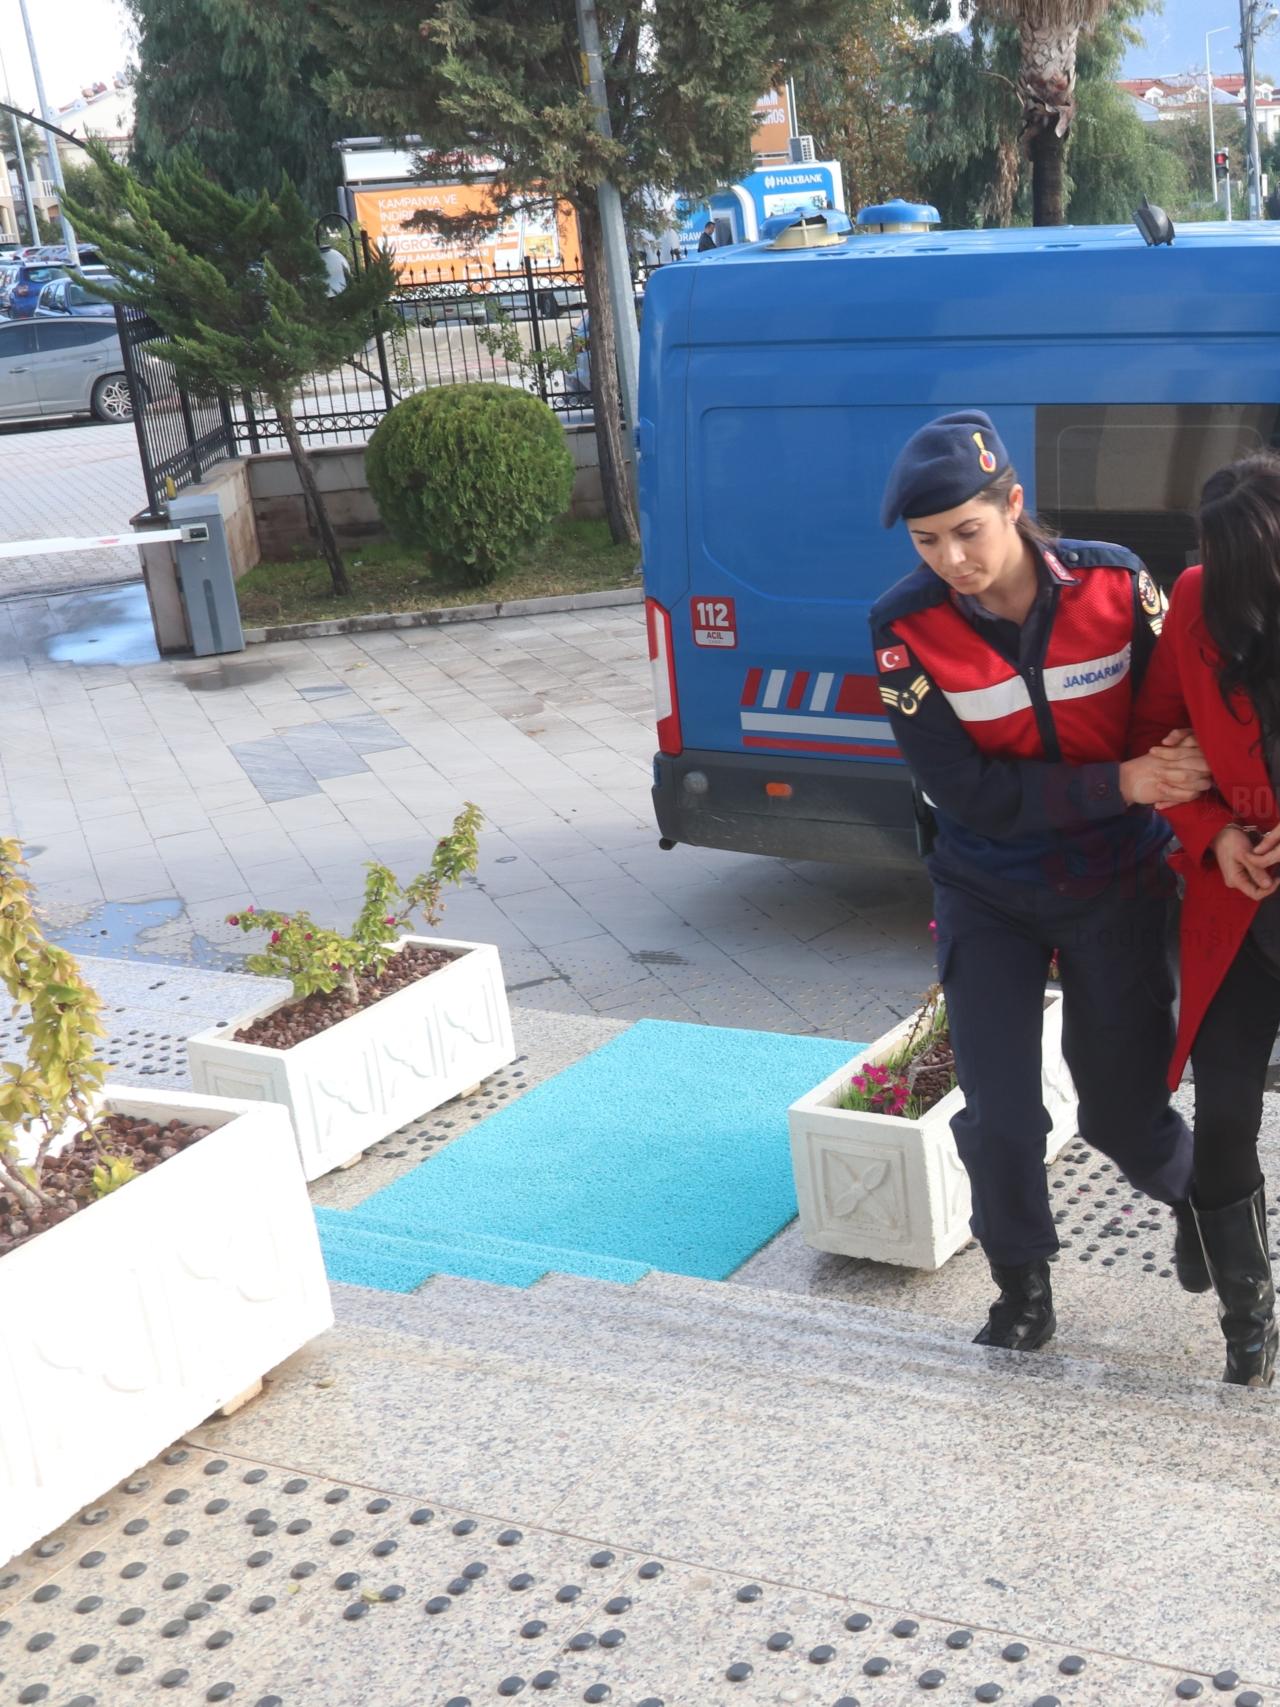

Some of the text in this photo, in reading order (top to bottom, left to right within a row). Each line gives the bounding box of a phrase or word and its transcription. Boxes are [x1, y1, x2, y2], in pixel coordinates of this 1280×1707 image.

[776, 173, 823, 186] HALKBANK
[378, 194, 457, 209] KAMPANYA VE
[696, 602, 729, 627] 112
